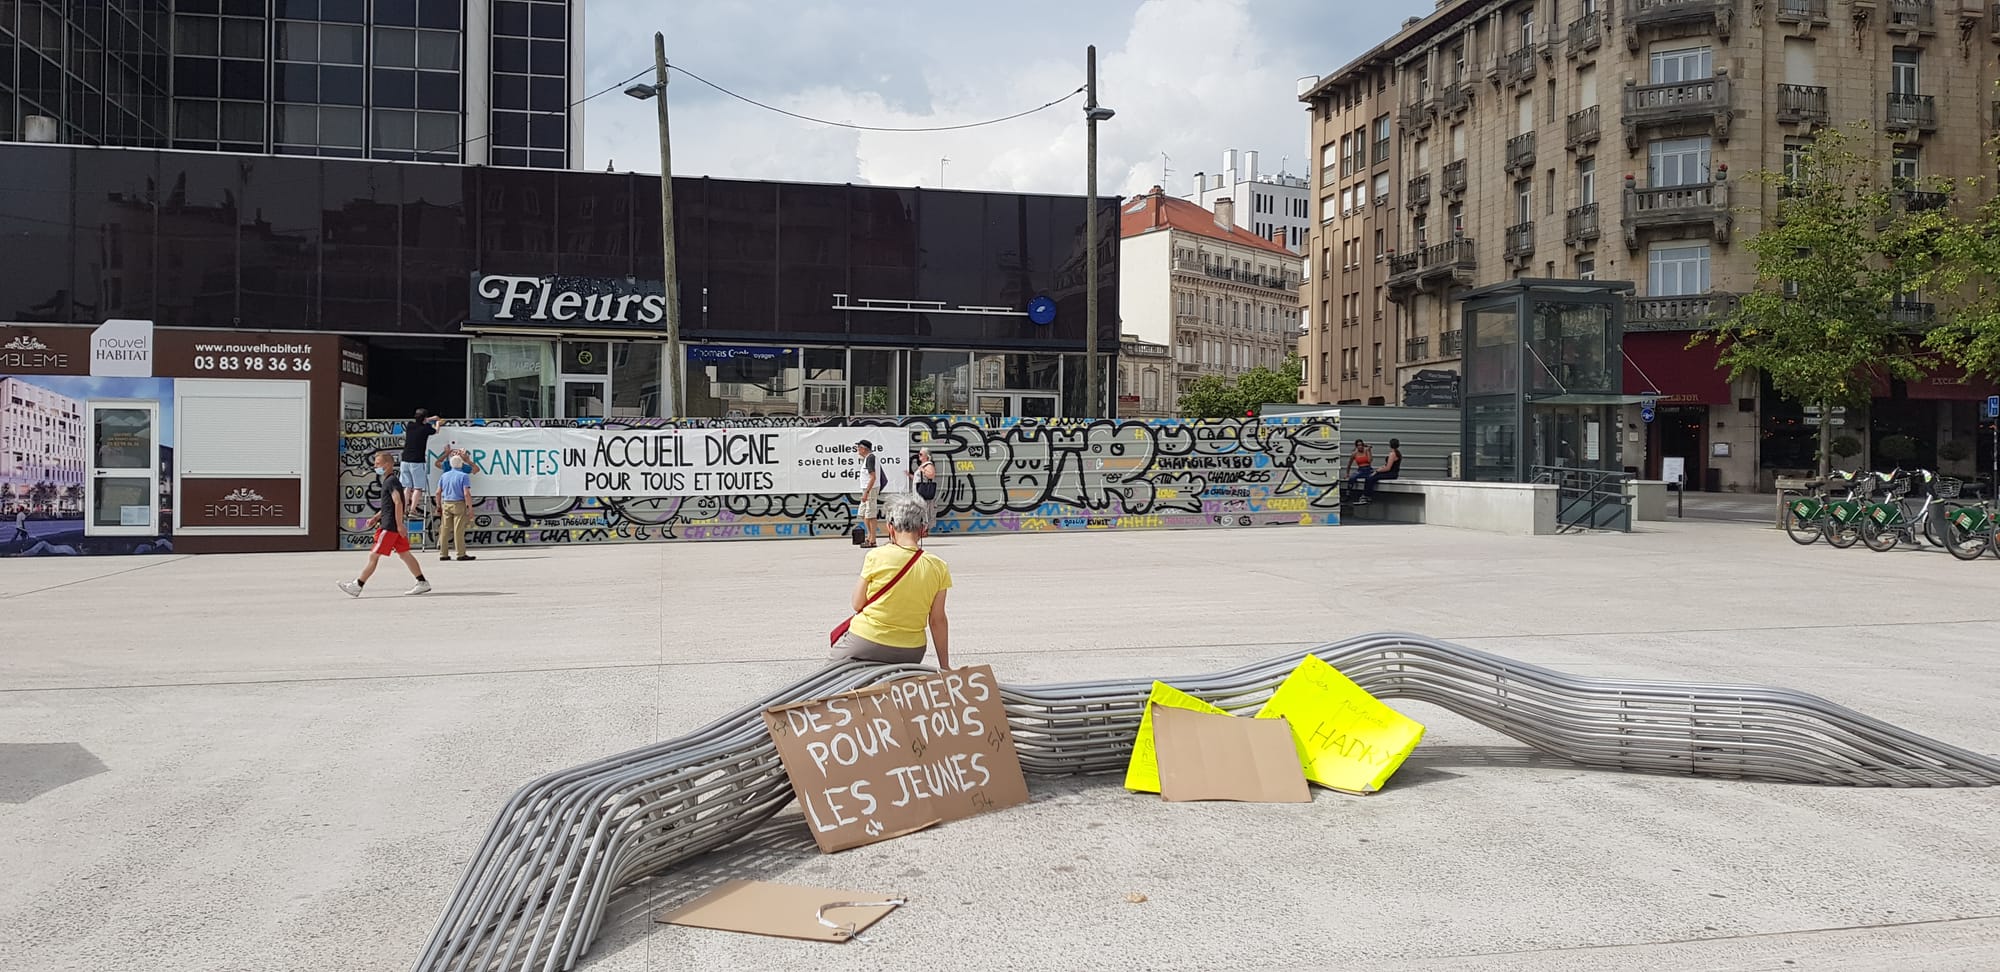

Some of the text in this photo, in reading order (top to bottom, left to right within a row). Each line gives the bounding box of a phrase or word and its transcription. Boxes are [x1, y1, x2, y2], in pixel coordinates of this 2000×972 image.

[478, 274, 666, 323] Fleurs
[99, 335, 146, 348] nouvel
[96, 349, 149, 361] HABITAT
[195, 344, 312, 354] www.nouvelhabitat.fr
[752, 352, 775, 360] oyages
[194, 356, 311, 371] 03 83 98 36 36
[564, 448, 586, 467] UN
[593, 431, 694, 467] ACCUEIL
[705, 429, 780, 466] DIGNE
[815, 445, 858, 454] Quelles
[798, 456, 901, 466] soient les rons
[585, 471, 773, 491] POUR TOUS ET TOUTES
[821, 470, 836, 479] du
[205, 504, 284, 517] EMBLEME
[786, 698, 852, 737] DES
[806, 706, 985, 779] POUR TOUS
[805, 752, 991, 833] LES JEUNES
